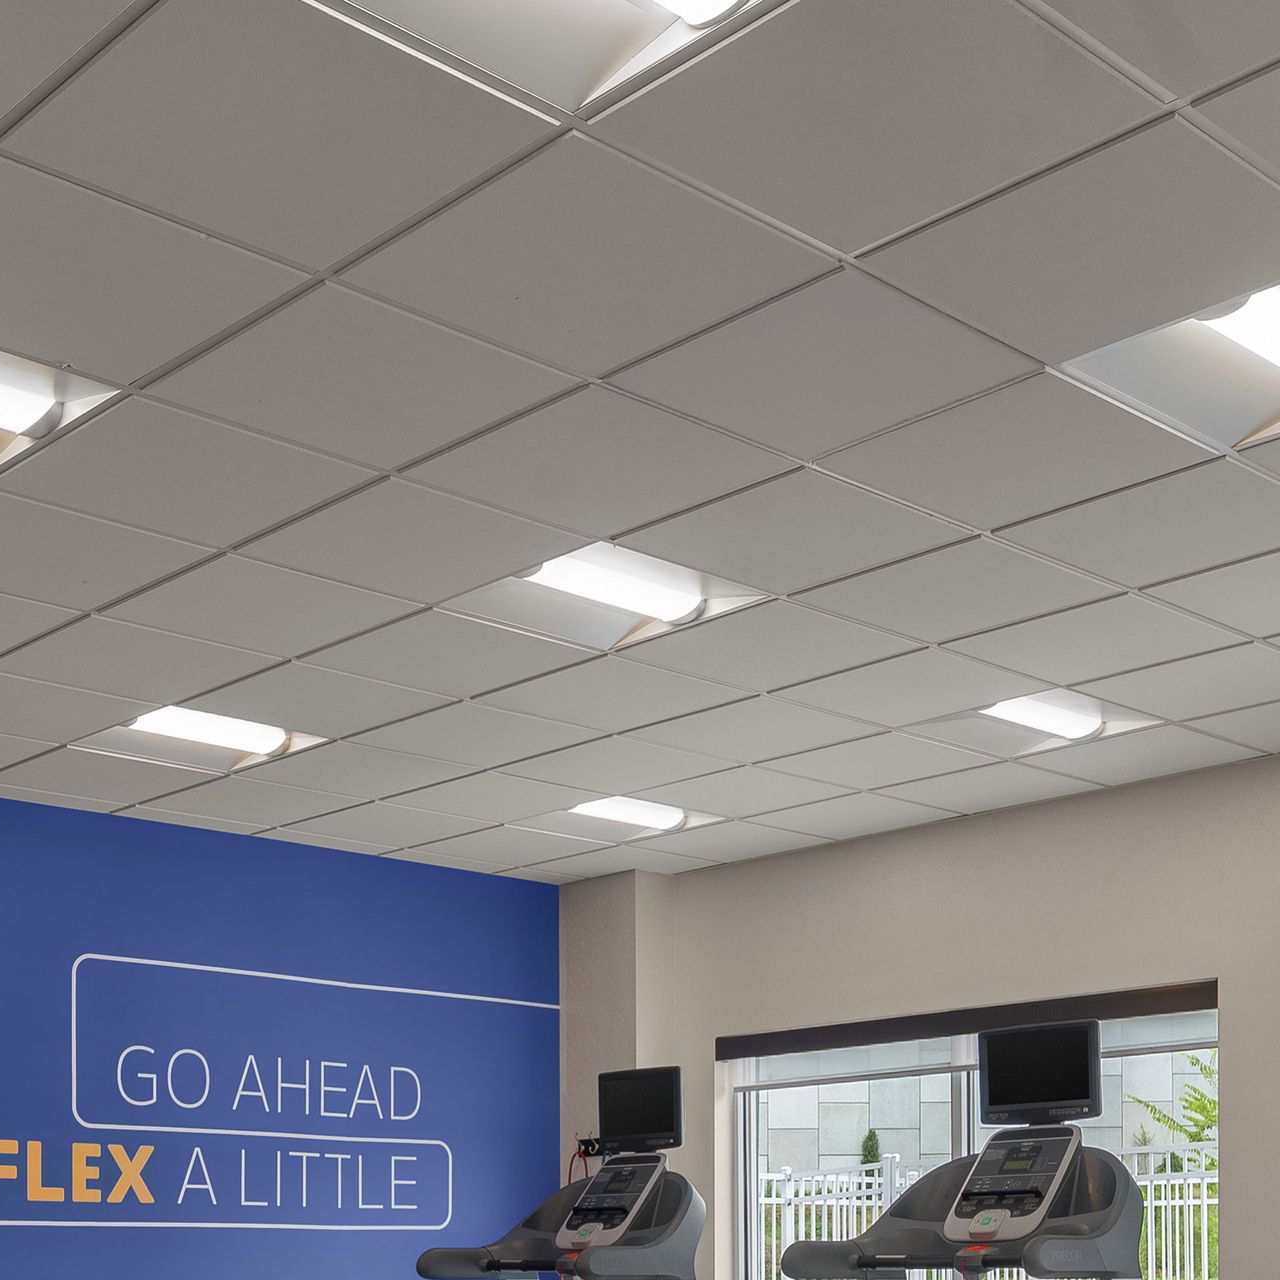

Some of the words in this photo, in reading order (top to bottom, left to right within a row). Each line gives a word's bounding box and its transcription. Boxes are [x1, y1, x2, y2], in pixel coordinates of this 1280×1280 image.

[117, 1045, 210, 1109] GO
[232, 1055, 421, 1120] AHEAD
[177, 1147, 216, 1205] A
[241, 1149, 418, 1209] LITTLE
